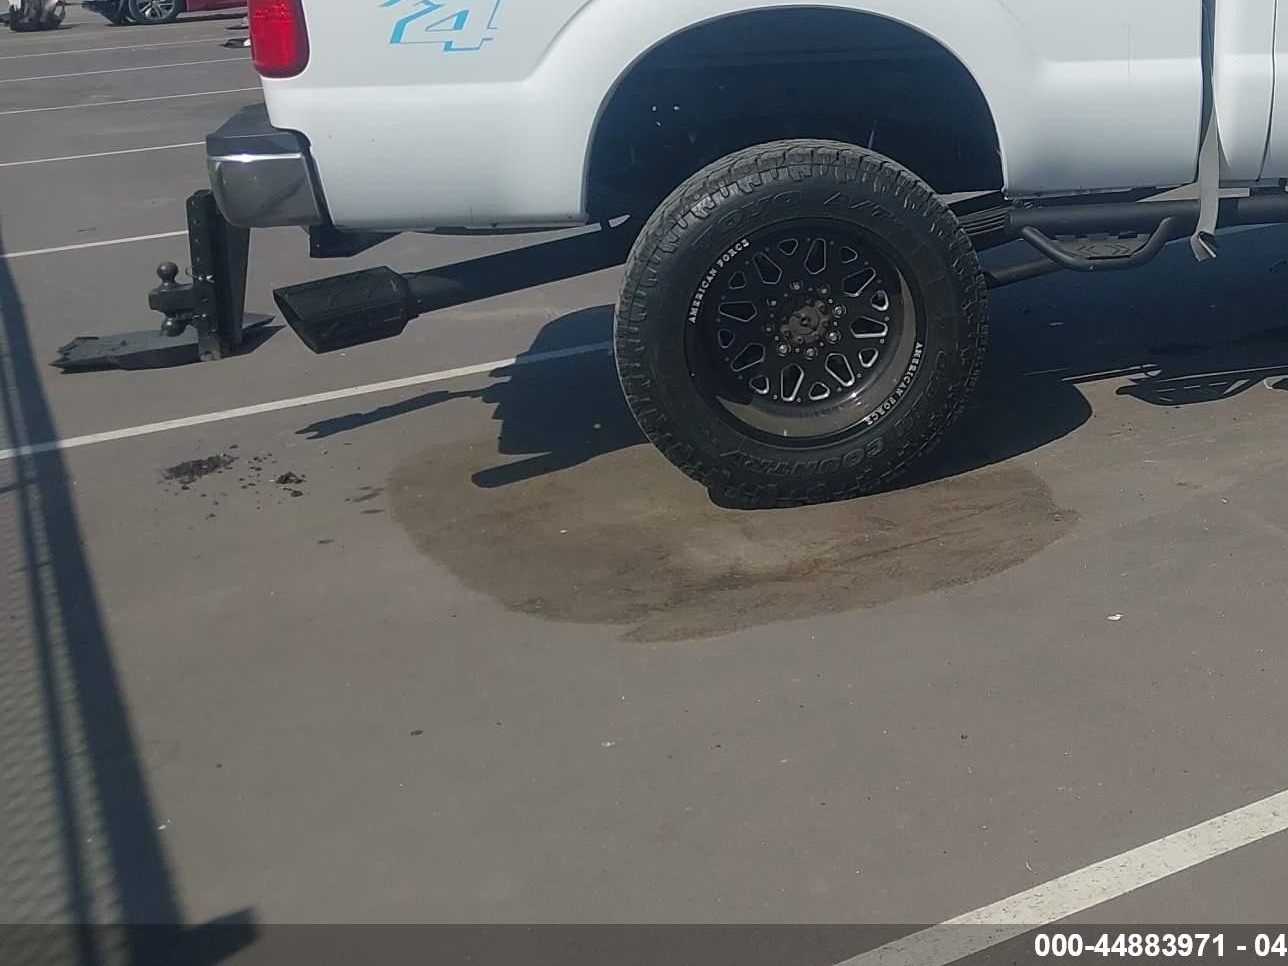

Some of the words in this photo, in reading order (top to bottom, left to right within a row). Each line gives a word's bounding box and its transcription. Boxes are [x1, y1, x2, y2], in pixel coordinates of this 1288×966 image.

[688, 267, 718, 325] AMERICAN
[716, 238, 750, 268] FORCE
[895, 341, 924, 397] AMERICAN
